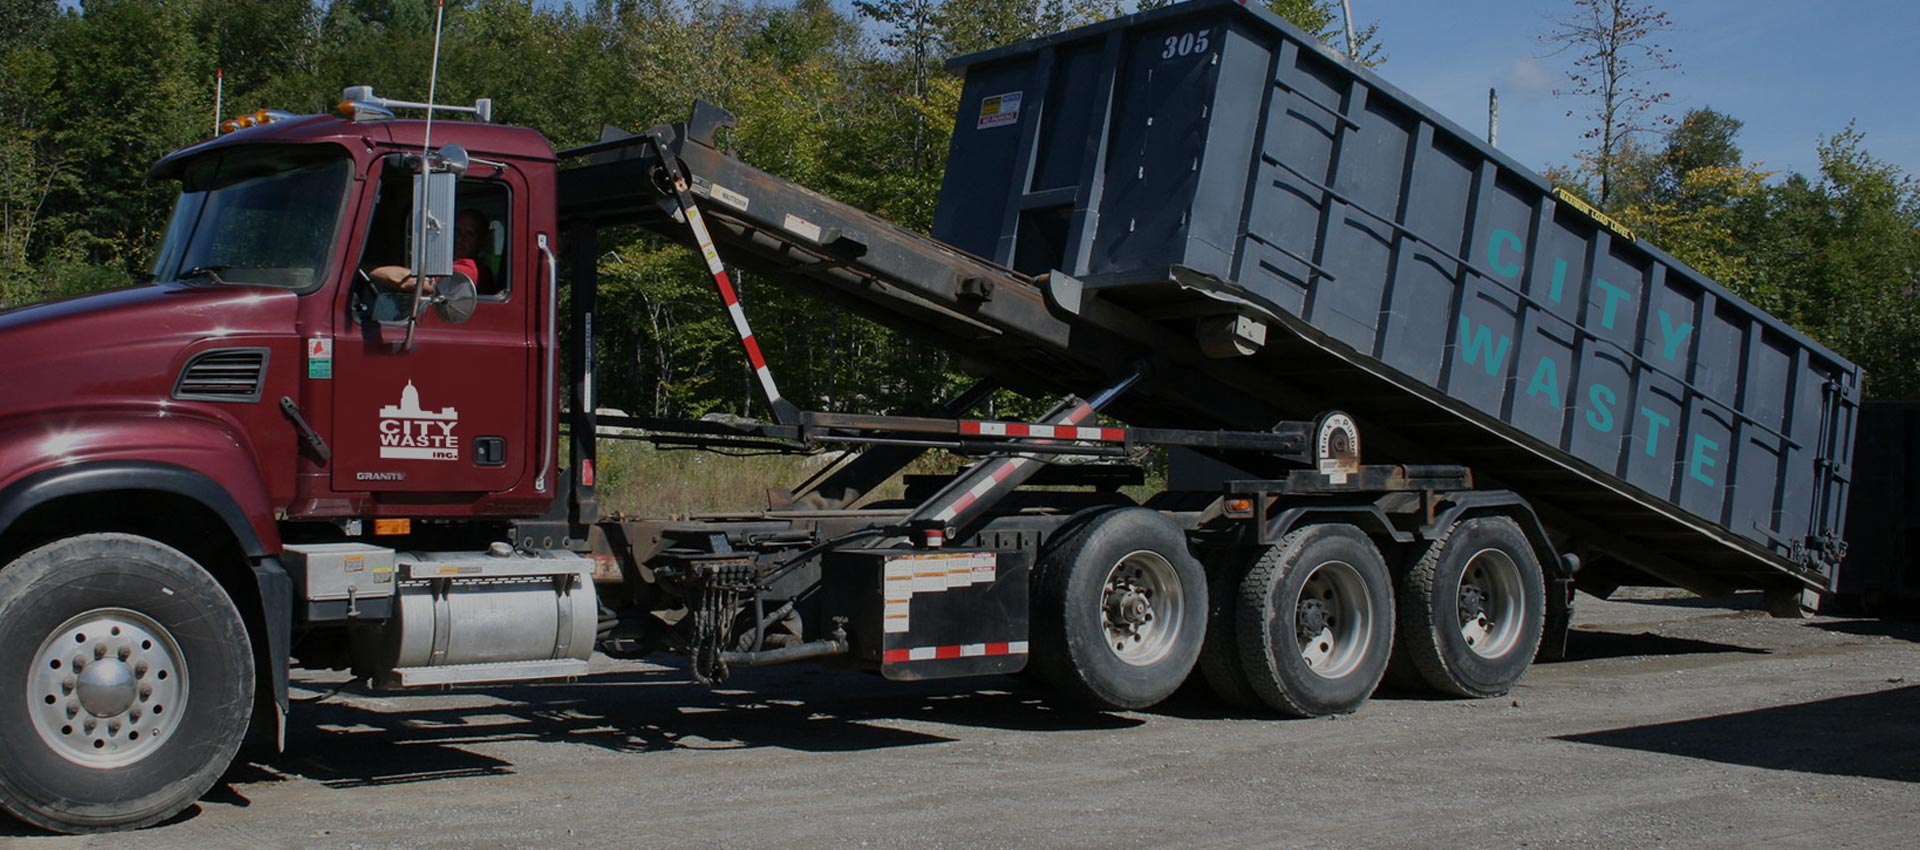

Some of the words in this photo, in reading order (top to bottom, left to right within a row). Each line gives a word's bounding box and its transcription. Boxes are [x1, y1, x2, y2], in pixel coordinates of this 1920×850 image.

[1162, 29, 1210, 59] 305
[1591, 209, 1609, 226] LOAD
[1610, 221, 1631, 240] LEVEL
[1487, 229, 1694, 361] CITY
[1459, 314, 1719, 487] WASTE
[379, 419, 457, 436] CITY
[380, 434, 458, 448] WASTE
[356, 471, 404, 481] GRANITE
